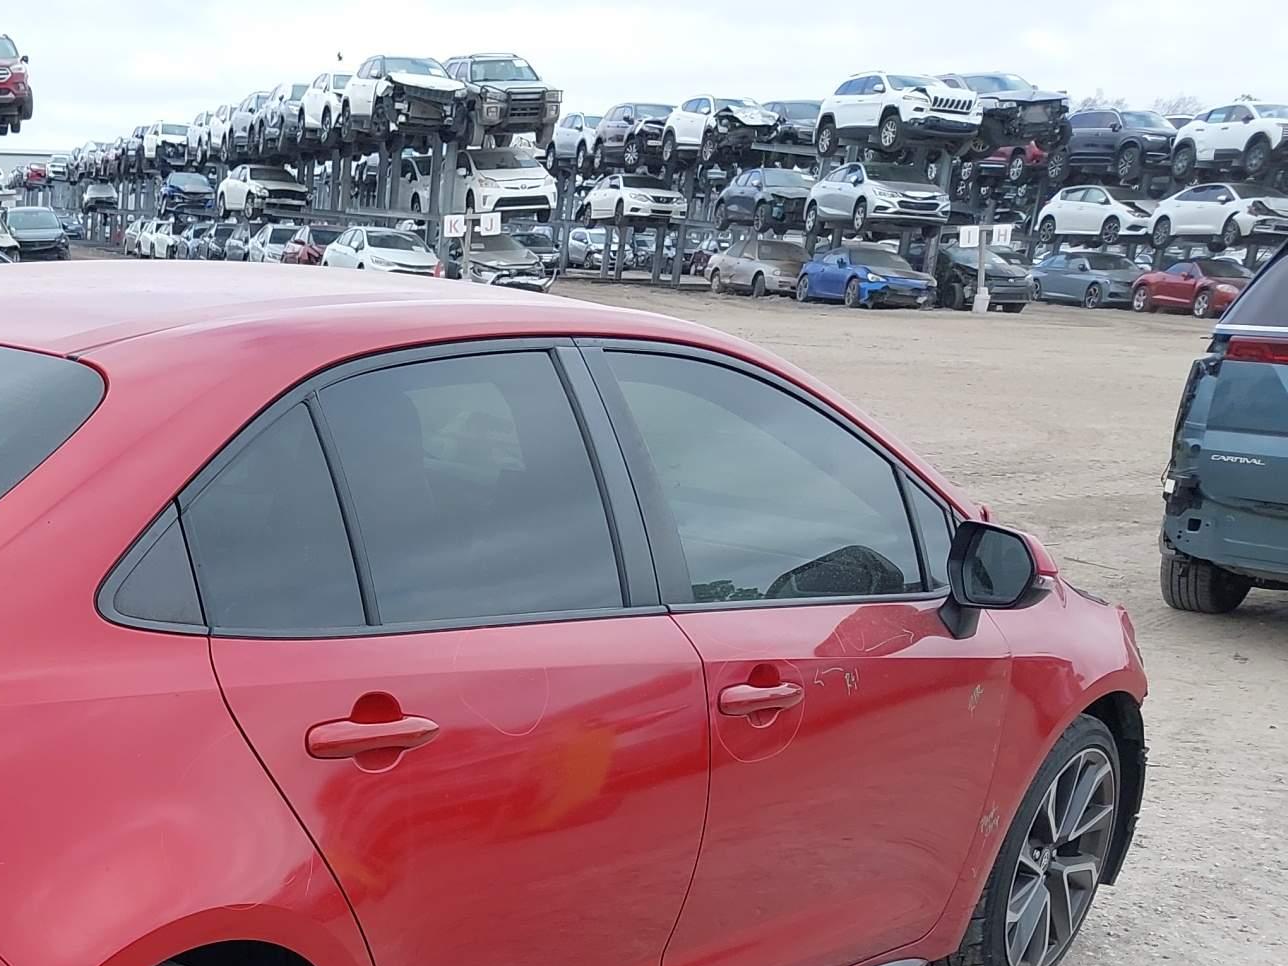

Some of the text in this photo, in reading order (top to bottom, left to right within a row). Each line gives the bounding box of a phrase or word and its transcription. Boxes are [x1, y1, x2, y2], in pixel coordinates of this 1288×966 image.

[449, 219, 459, 234] K
[484, 217, 494, 232] J
[997, 228, 1008, 242] H
[1211, 454, 1266, 466] CARNIVAL
